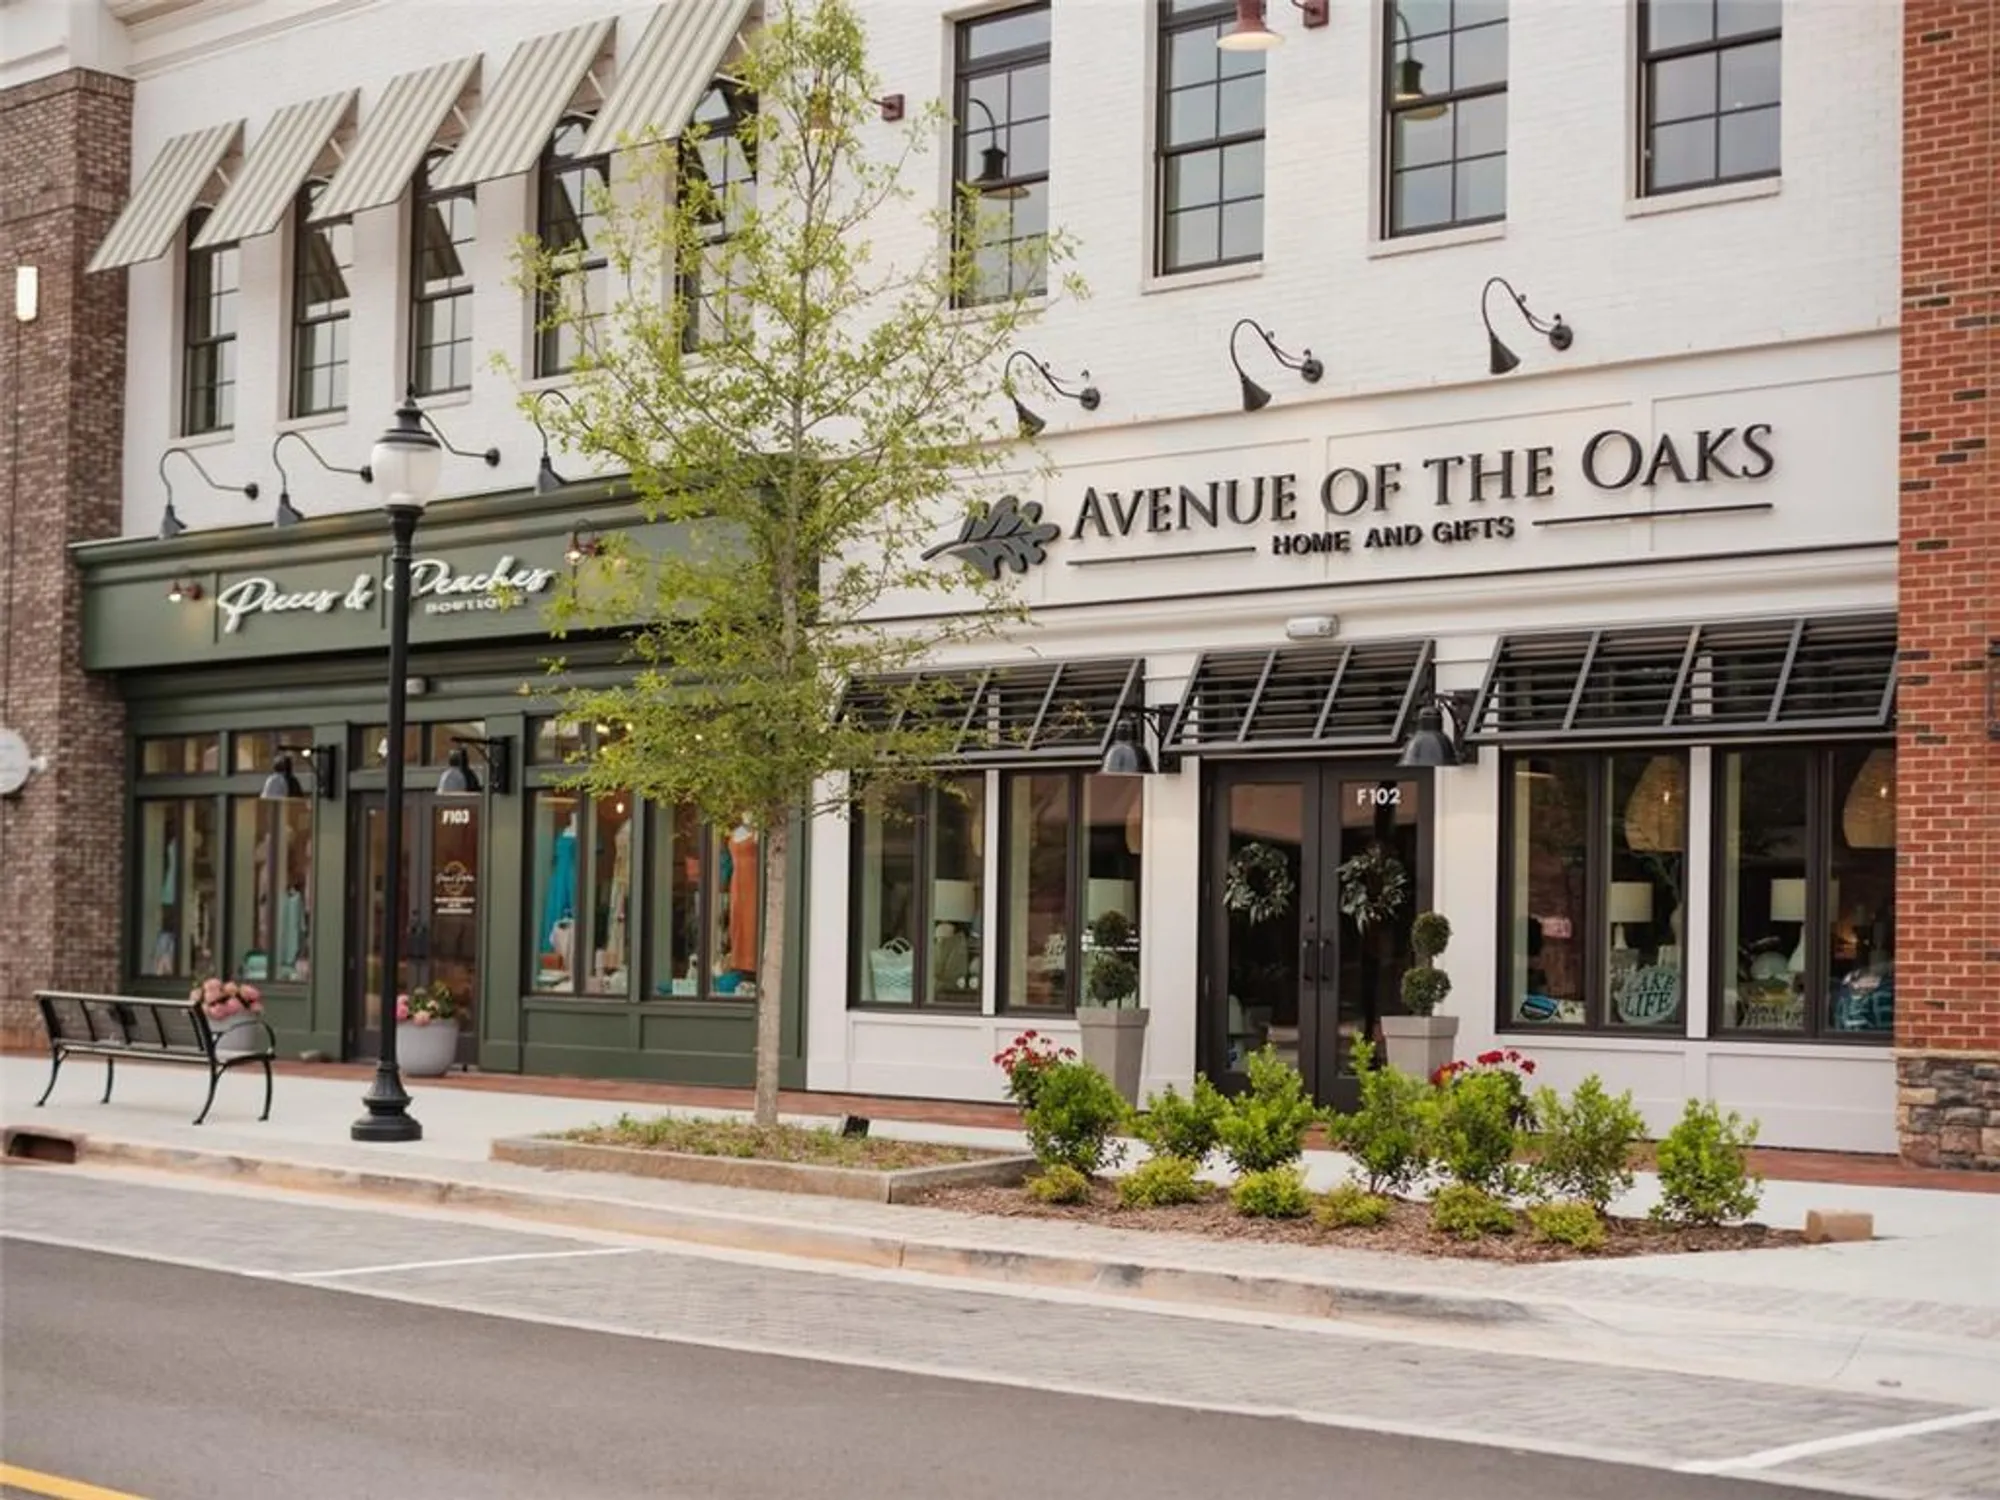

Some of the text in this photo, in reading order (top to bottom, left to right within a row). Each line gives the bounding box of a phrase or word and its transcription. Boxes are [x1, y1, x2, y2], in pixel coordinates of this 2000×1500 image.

[1070, 423, 1775, 541] AVENUE OF THE OAKS
[1272, 516, 1516, 556] HOME AND GIFTS
[344, 573, 374, 611] &
[1356, 787, 1401, 806] F102
[1624, 991, 1673, 1017] LIFE
